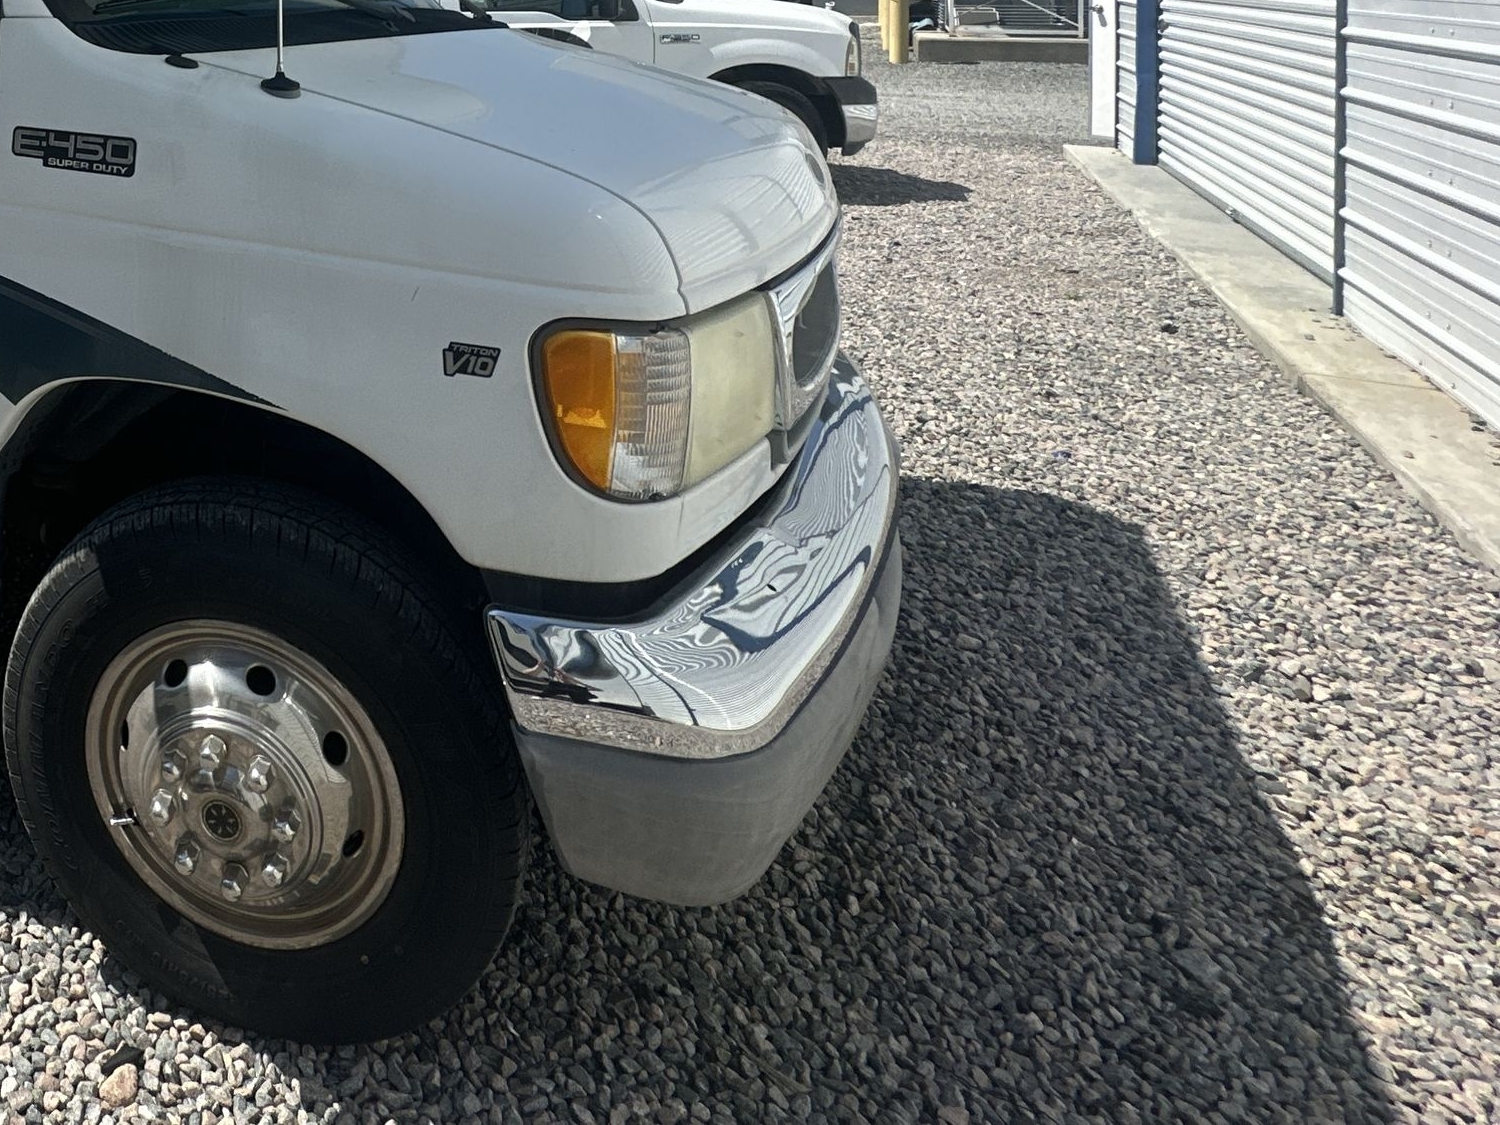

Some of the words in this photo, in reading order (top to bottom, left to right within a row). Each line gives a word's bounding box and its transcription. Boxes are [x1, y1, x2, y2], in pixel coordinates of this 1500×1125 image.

[47, 157, 90, 170] SUPER
[92, 162, 129, 175] DUTY
[451, 343, 499, 357] TRITON
[444, 350, 495, 377] V10
